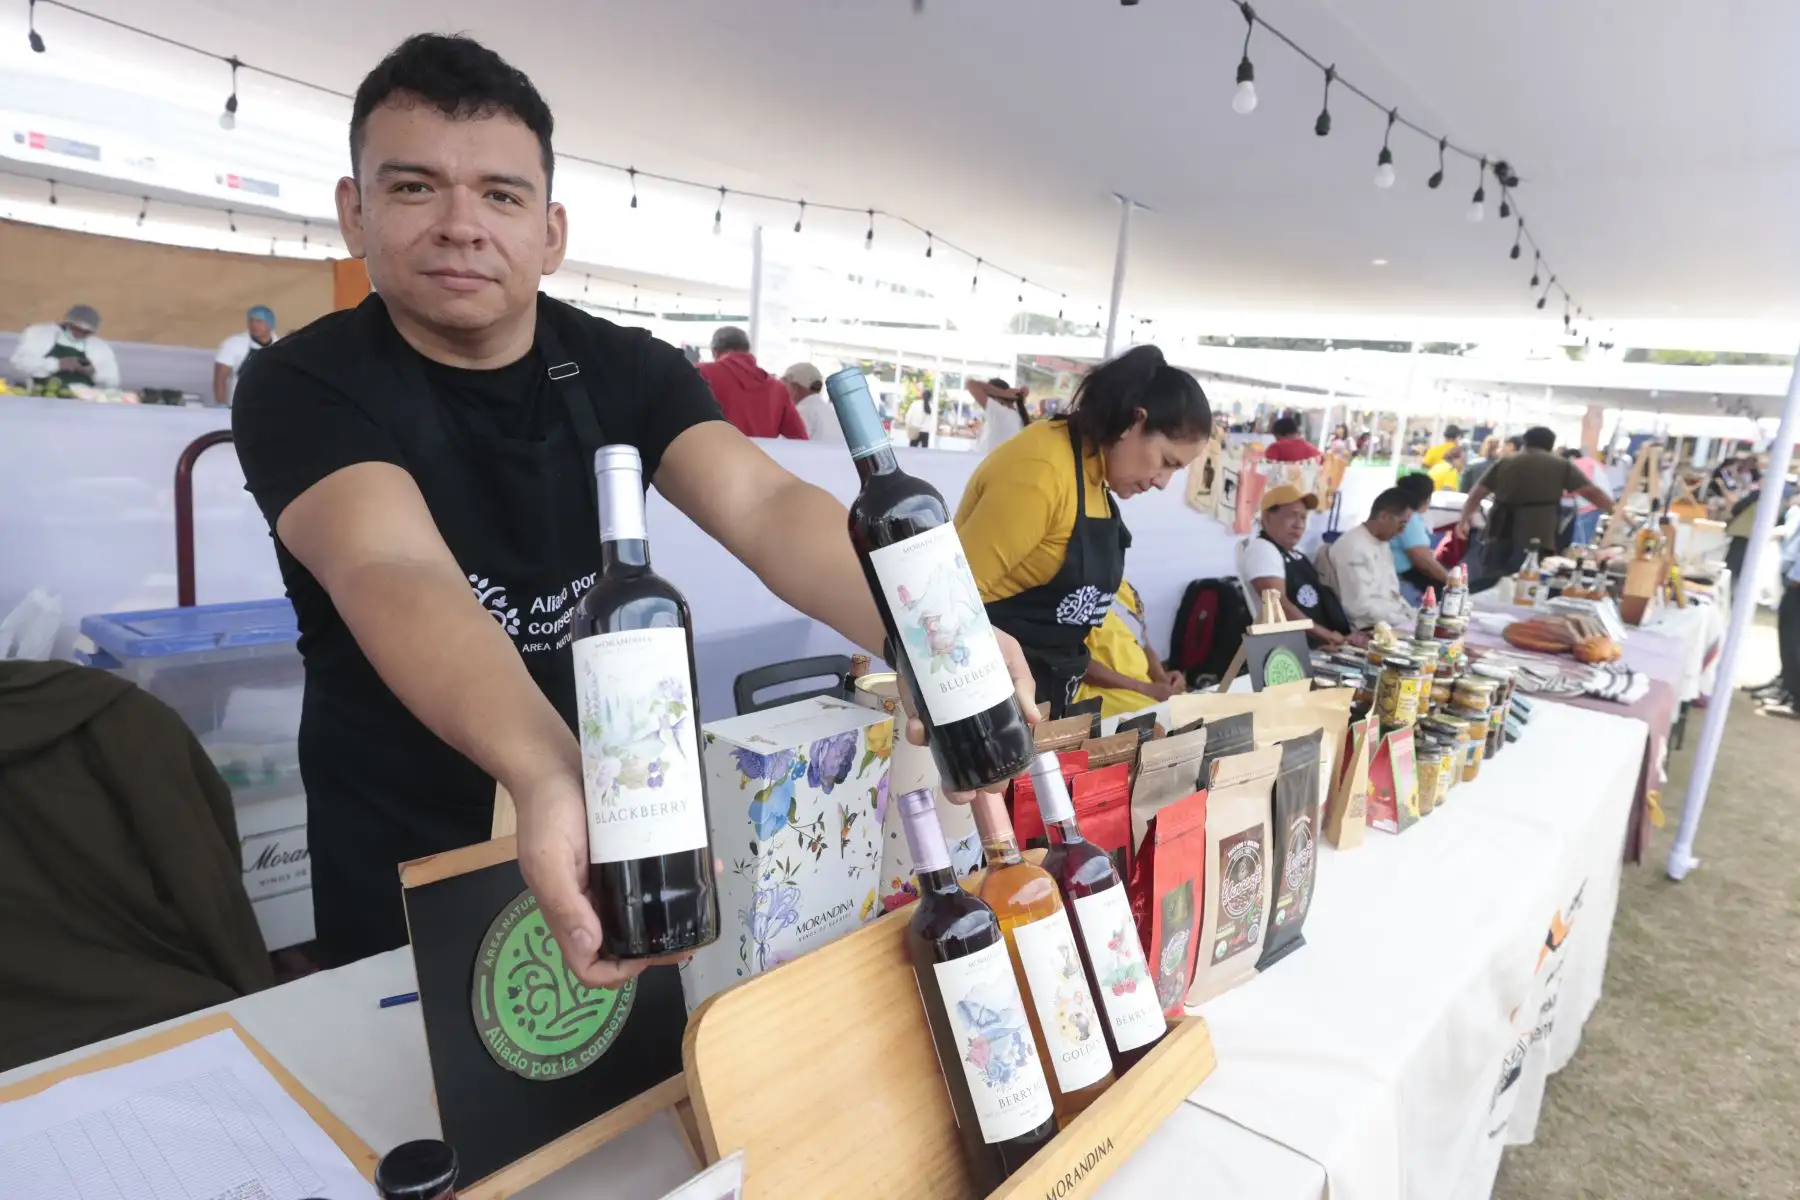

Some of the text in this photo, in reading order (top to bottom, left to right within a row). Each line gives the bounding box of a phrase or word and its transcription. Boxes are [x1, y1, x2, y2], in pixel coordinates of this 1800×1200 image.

[571, 572, 597, 598] por
[939, 659, 1001, 694] BLUEBERRY
[595, 798, 688, 825] BLACKBERRY
[501, 895, 537, 929] NATUR
[795, 898, 855, 937] MORANDINA
[1115, 1008, 1147, 1027] BERRY
[485, 1026, 529, 1070] Aliado
[529, 1060, 559, 1078] por
[561, 1055, 578, 1072] la
[998, 1086, 1034, 1110] BERRY
[1046, 1136, 1114, 1200] MORANDINA
